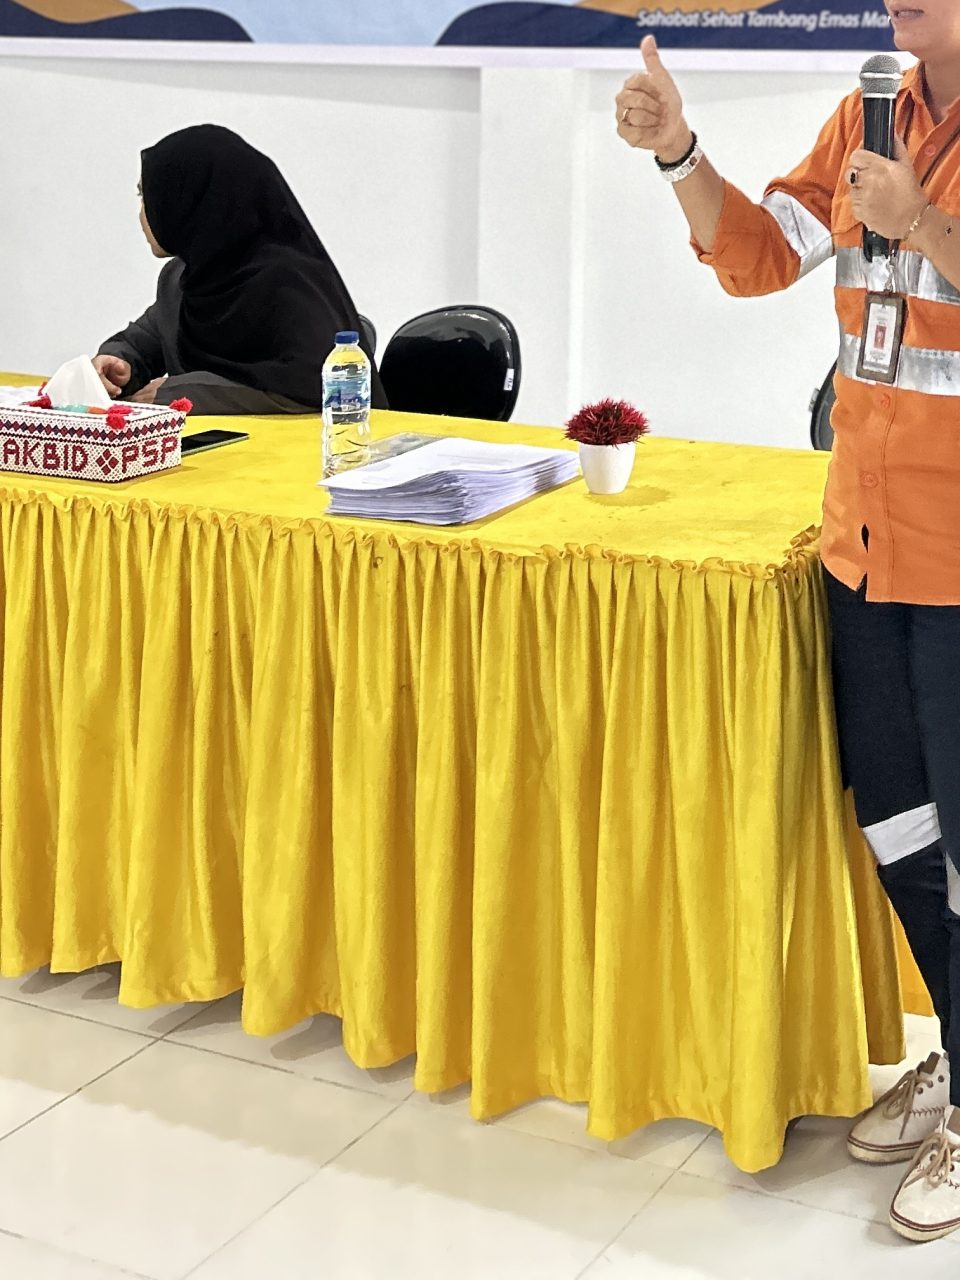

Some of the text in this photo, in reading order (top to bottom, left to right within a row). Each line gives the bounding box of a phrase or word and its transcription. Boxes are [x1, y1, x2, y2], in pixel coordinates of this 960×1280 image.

[637, 10, 698, 28] Sahabat
[701, 10, 744, 28] Sehat
[747, 10, 816, 32] Tambang
[819, 11, 860, 28] Emas
[3, 435, 178, 473] AKBID PSP
